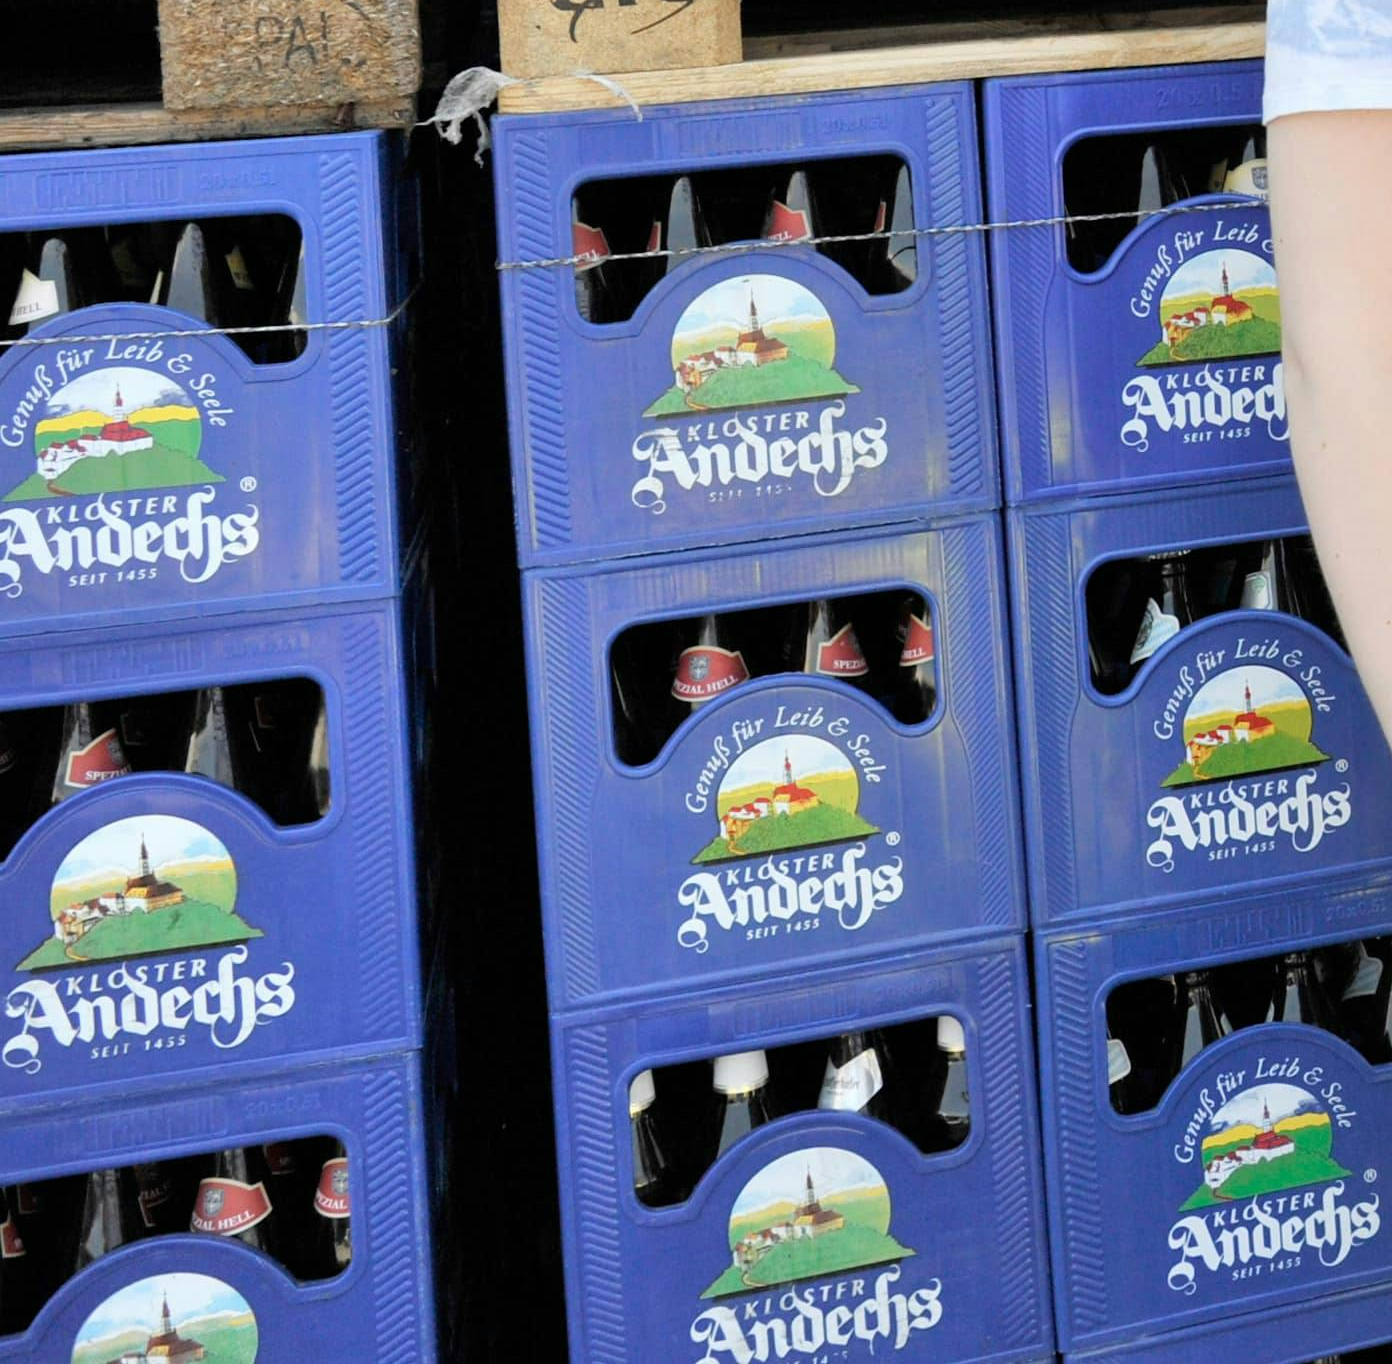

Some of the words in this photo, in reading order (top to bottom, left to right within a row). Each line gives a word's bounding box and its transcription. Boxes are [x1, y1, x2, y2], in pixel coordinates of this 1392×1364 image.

[56, 348, 94, 386] für
[104, 338, 163, 363] Leib
[189, 373, 234, 427] Seele
[1166, 367, 1265, 389] KLOSTER
[688, 411, 810, 442] KLOSTER
[632, 400, 888, 515] Andechs
[47, 496, 177, 524] KLOSTER
[0, 485, 259, 598] Andechs
[707, 675, 738, 693] HELL
[733, 717, 764, 754] für
[774, 704, 825, 727] Leib
[847, 737, 883, 786] Seele
[1191, 778, 1289, 809] KLOSTER
[1146, 768, 1351, 873] Andechs
[727, 852, 835, 886] KLOSTER
[678, 841, 903, 953] Andechs
[747, 925, 778, 939] SEIT
[787, 918, 819, 932] 1455
[68, 957, 208, 996] KLOSTER
[3, 944, 295, 1074] Andechs
[92, 1042, 132, 1059] SEIT
[143, 1035, 186, 1051] 1455
[1217, 1070, 1245, 1105] für
[1255, 1057, 1301, 1079] Leib
[1322, 1083, 1357, 1127] Seele
[218, 1210, 255, 1229] HELL
[1214, 1191, 1315, 1228] KLOSTER
[1168, 1179, 1380, 1295] Andechs
[1232, 1265, 1262, 1280] SEIT
[1270, 1257, 1301, 1272] 1455
[689, 1264, 942, 1364] Andechs
